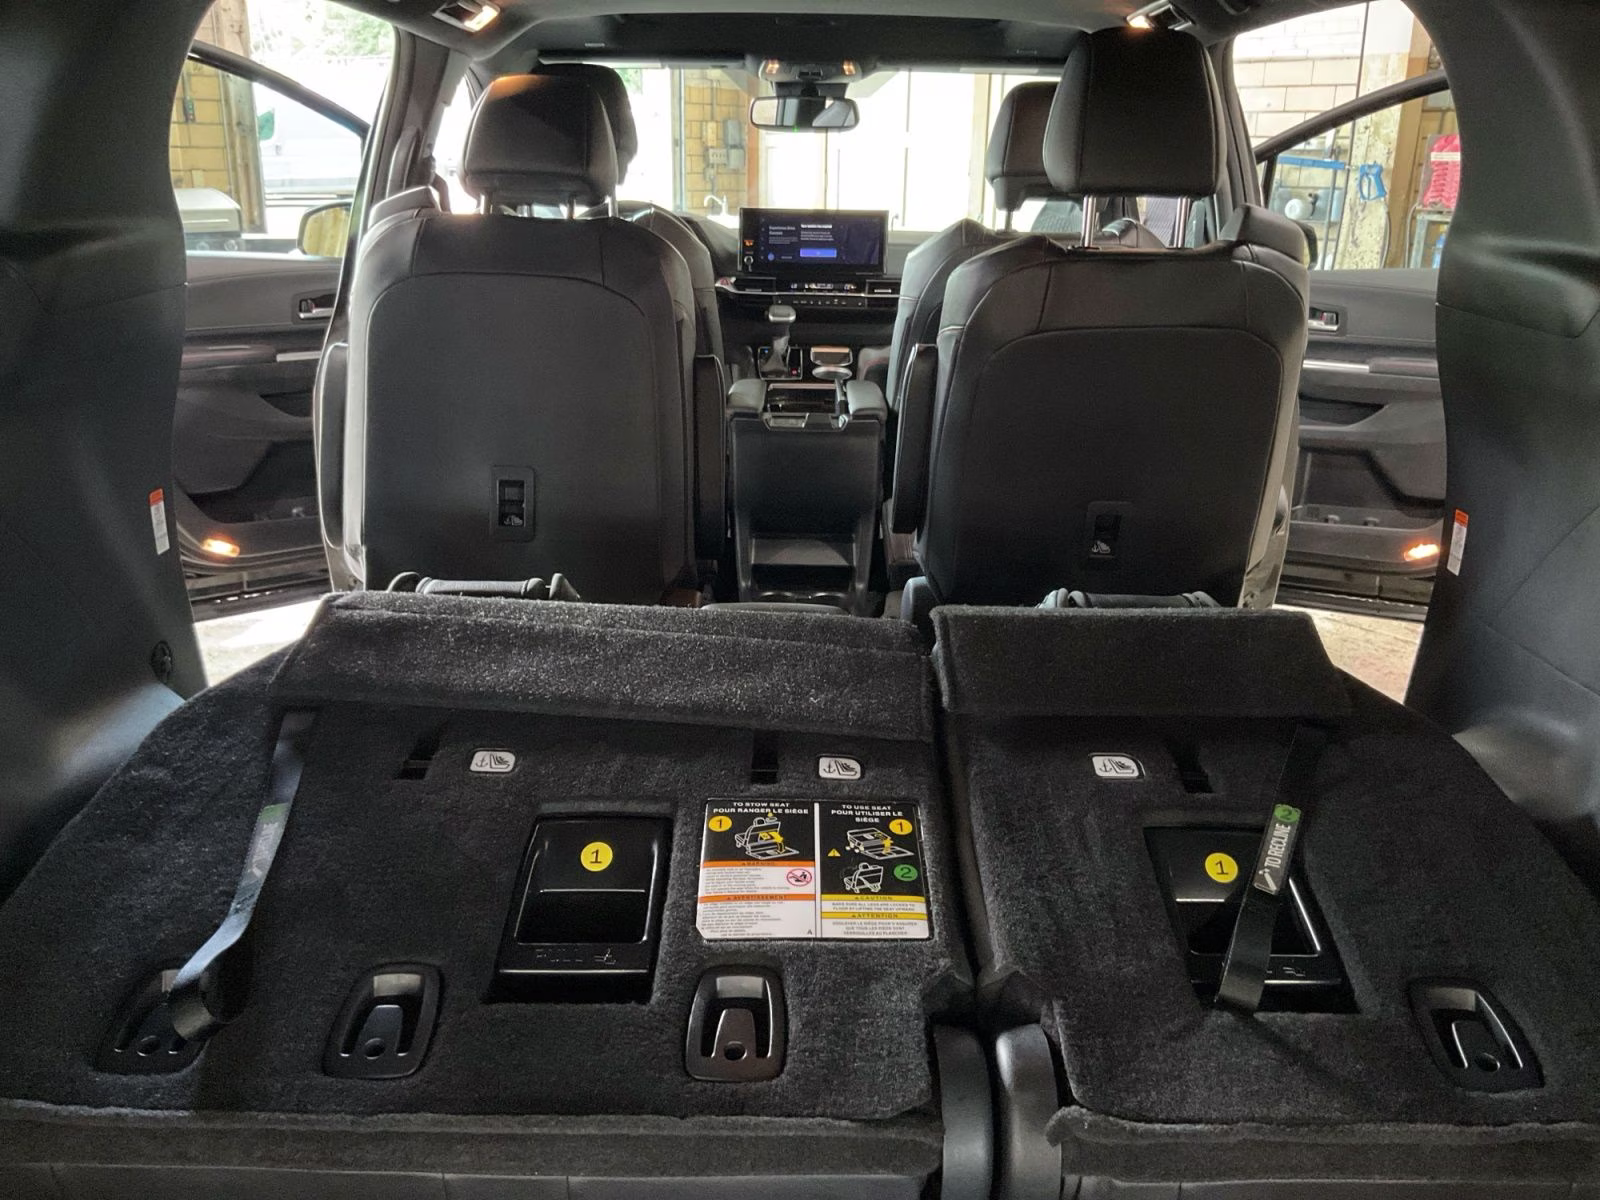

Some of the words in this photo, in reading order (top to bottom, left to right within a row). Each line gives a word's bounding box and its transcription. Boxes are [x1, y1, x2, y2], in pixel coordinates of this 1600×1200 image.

[1280, 808, 1293, 820] 2
[1268, 823, 1291, 857] RECLINE
[590, 849, 602, 864] 1
[1264, 855, 1281, 868] TO
[900, 866, 912, 878] 2
[1215, 860, 1229, 875] 1
